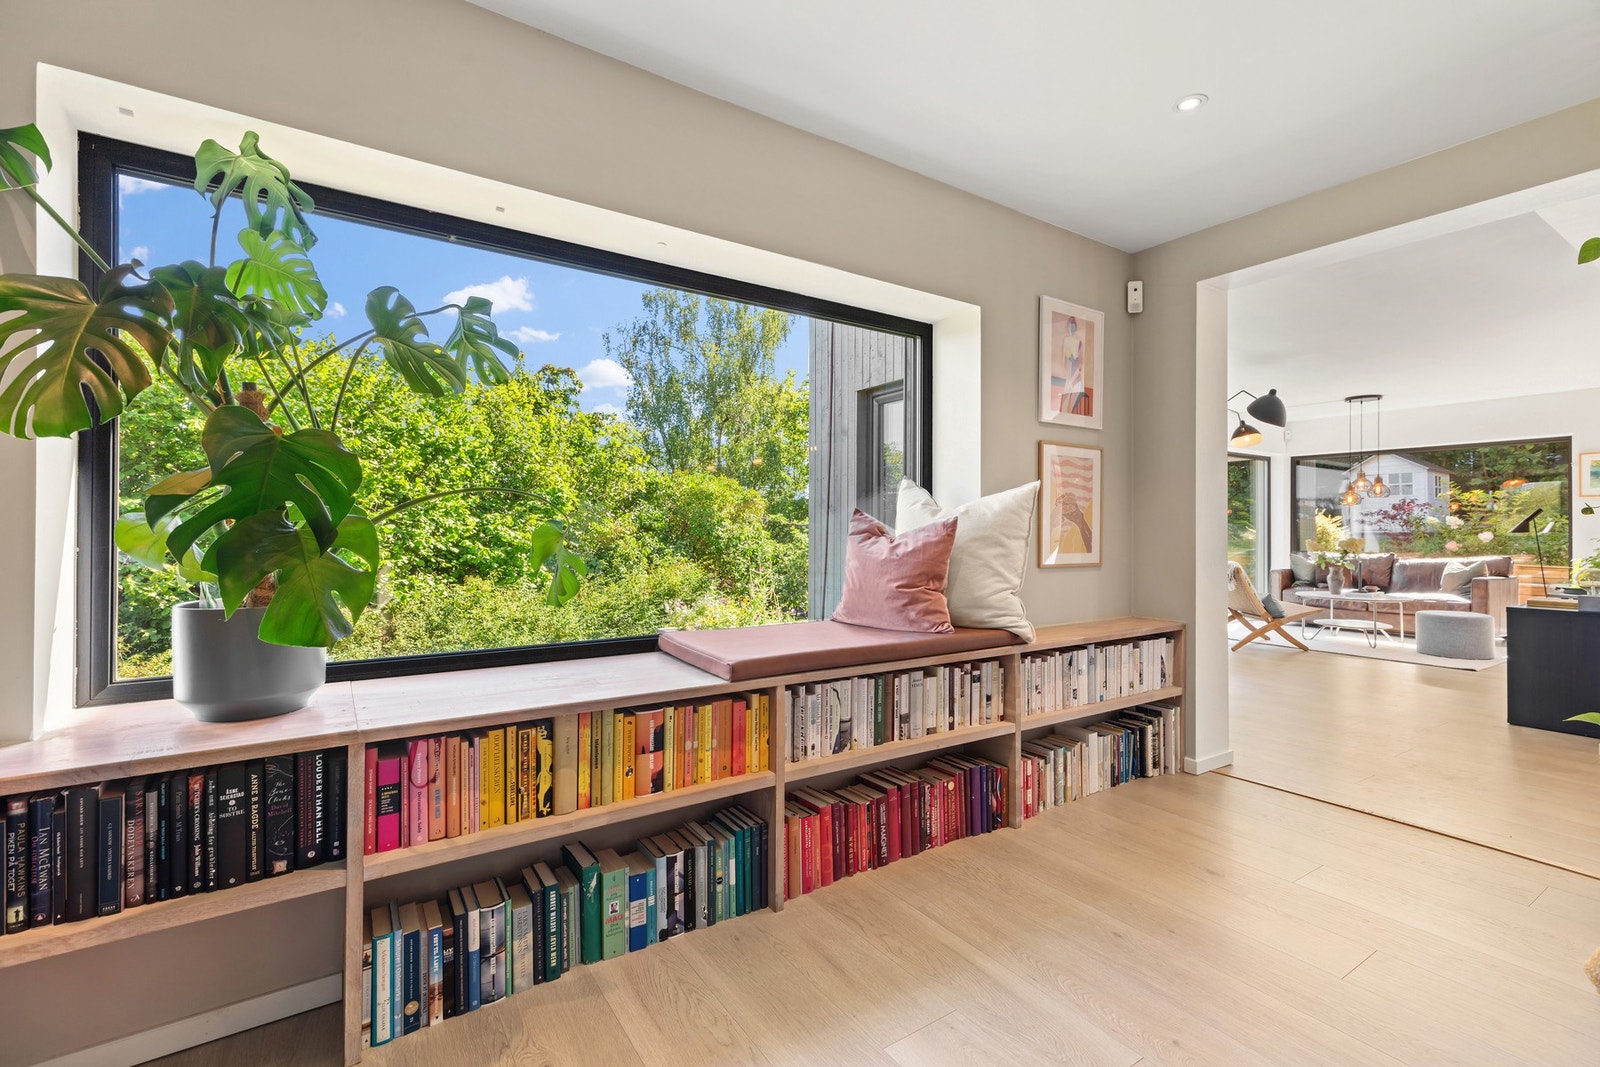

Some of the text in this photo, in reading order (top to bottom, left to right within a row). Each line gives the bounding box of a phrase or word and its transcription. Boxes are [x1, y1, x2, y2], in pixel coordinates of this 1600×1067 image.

[268, 788, 288, 796] Bone
[268, 795, 290, 804] Clocks
[268, 808, 292, 817] Mitchell
[207, 812, 215, 835] Avdeling
[39, 826, 51, 845] IAN
[207, 836, 215, 845] for
[606, 914, 623, 924] MAO
